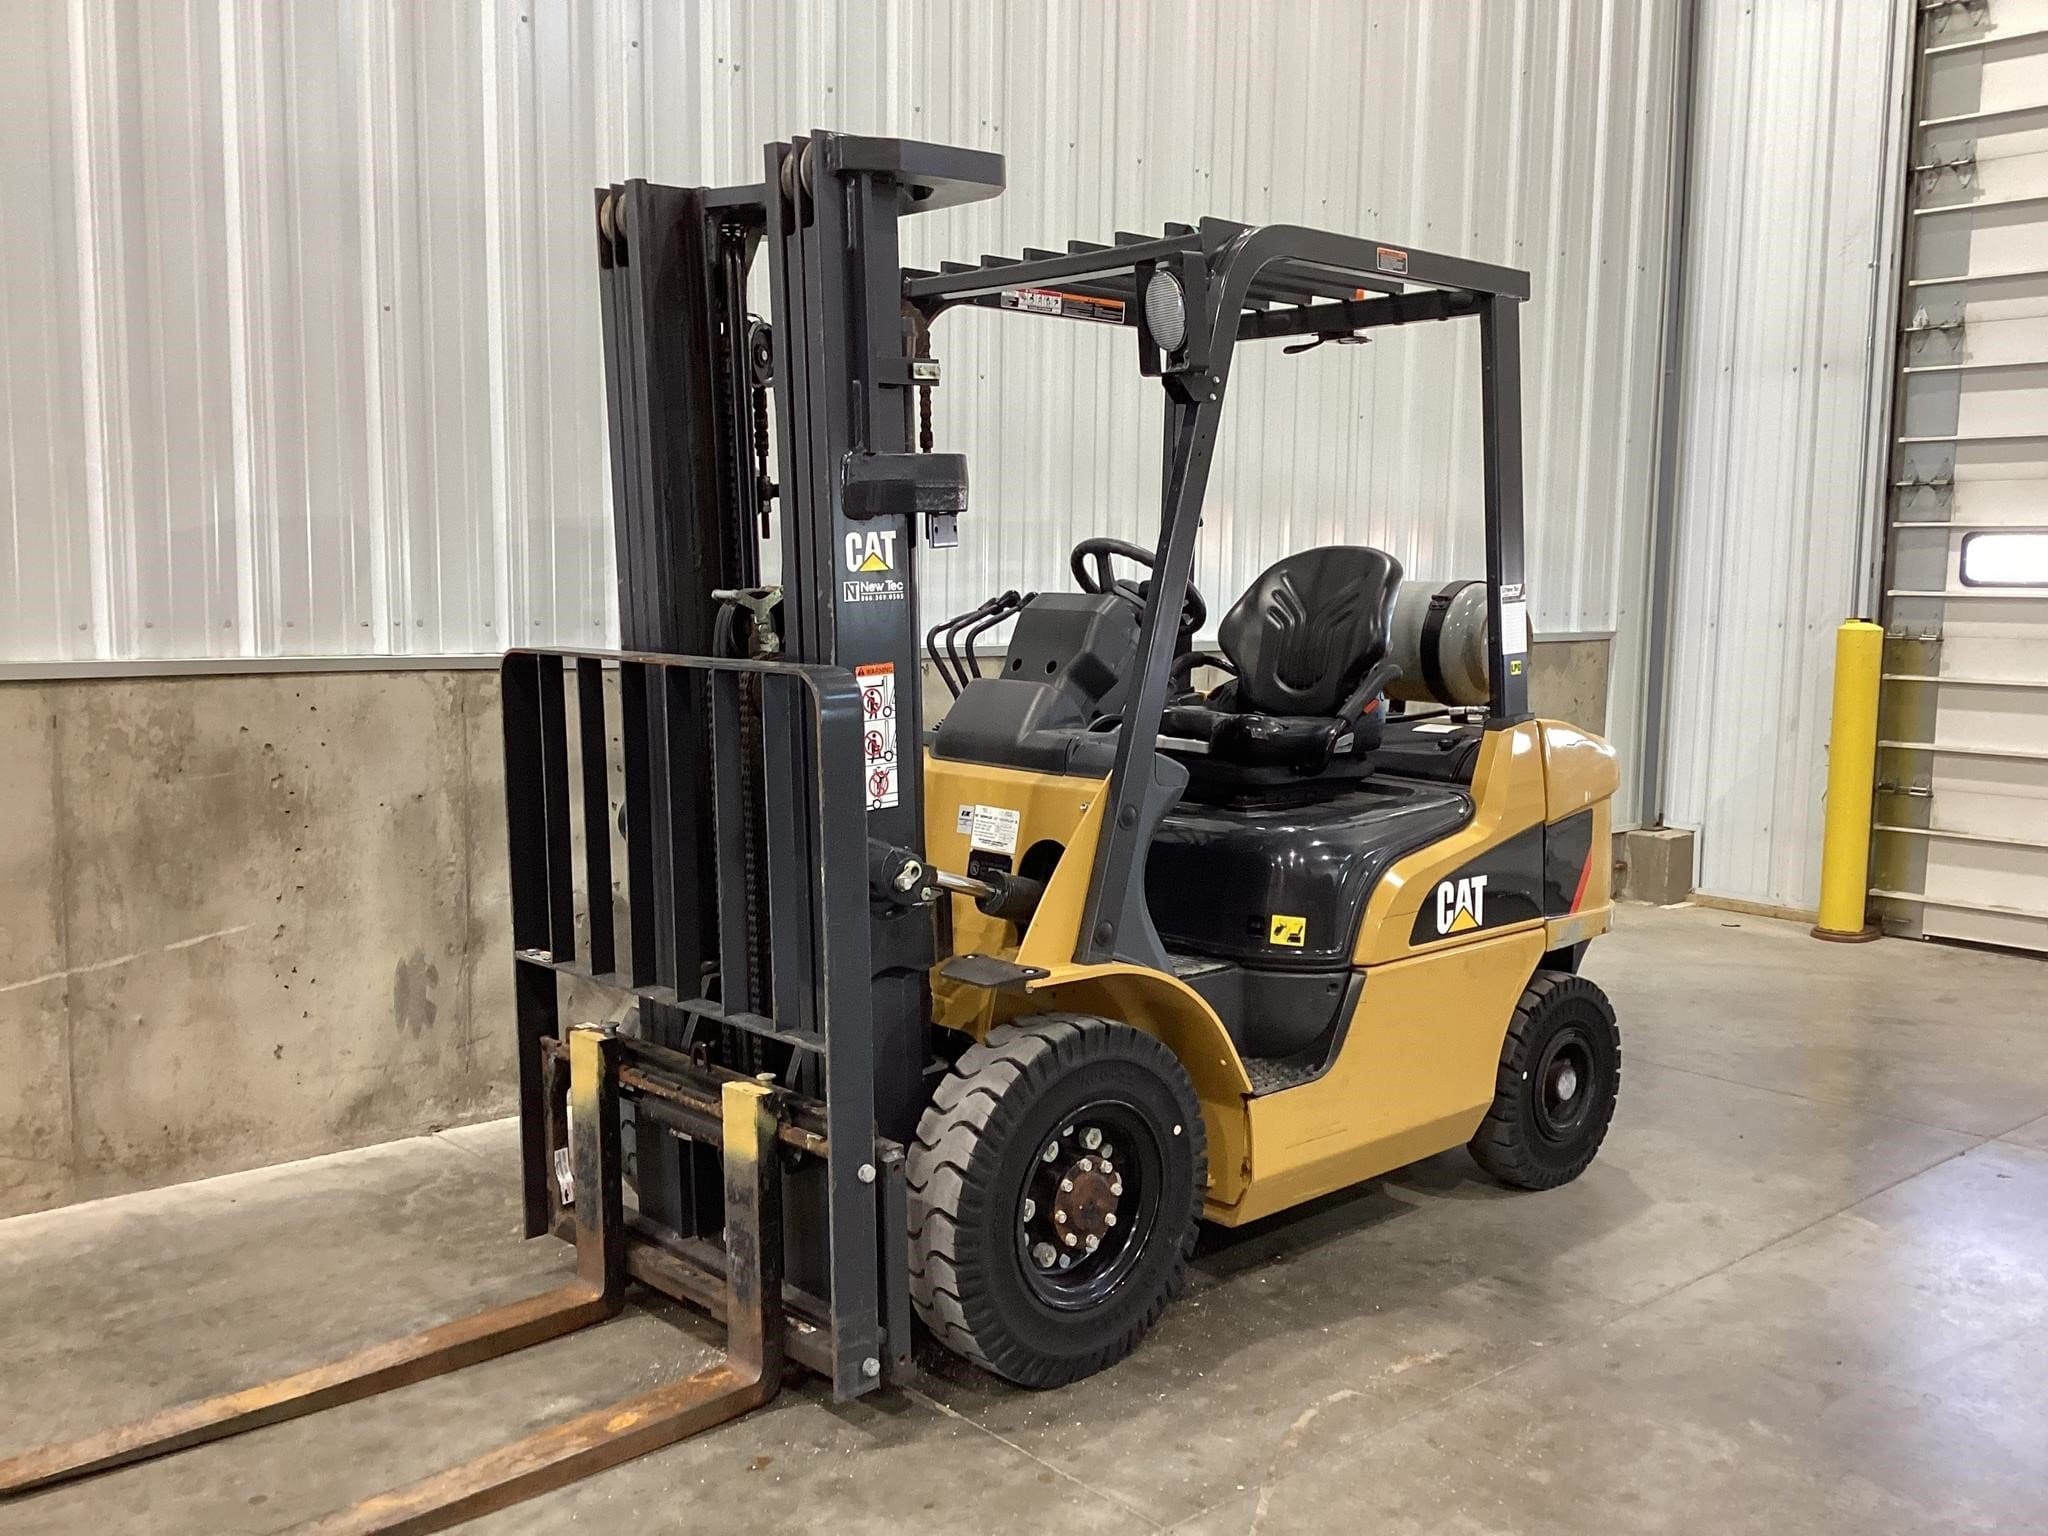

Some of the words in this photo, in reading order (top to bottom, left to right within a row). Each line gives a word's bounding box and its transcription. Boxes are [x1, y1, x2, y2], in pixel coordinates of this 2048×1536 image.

[845, 530, 897, 573] CAT
[860, 581, 885, 593] New
[885, 579, 904, 591] Tec
[866, 665, 893, 675] WARNING
[1437, 874, 1488, 935] CAT
